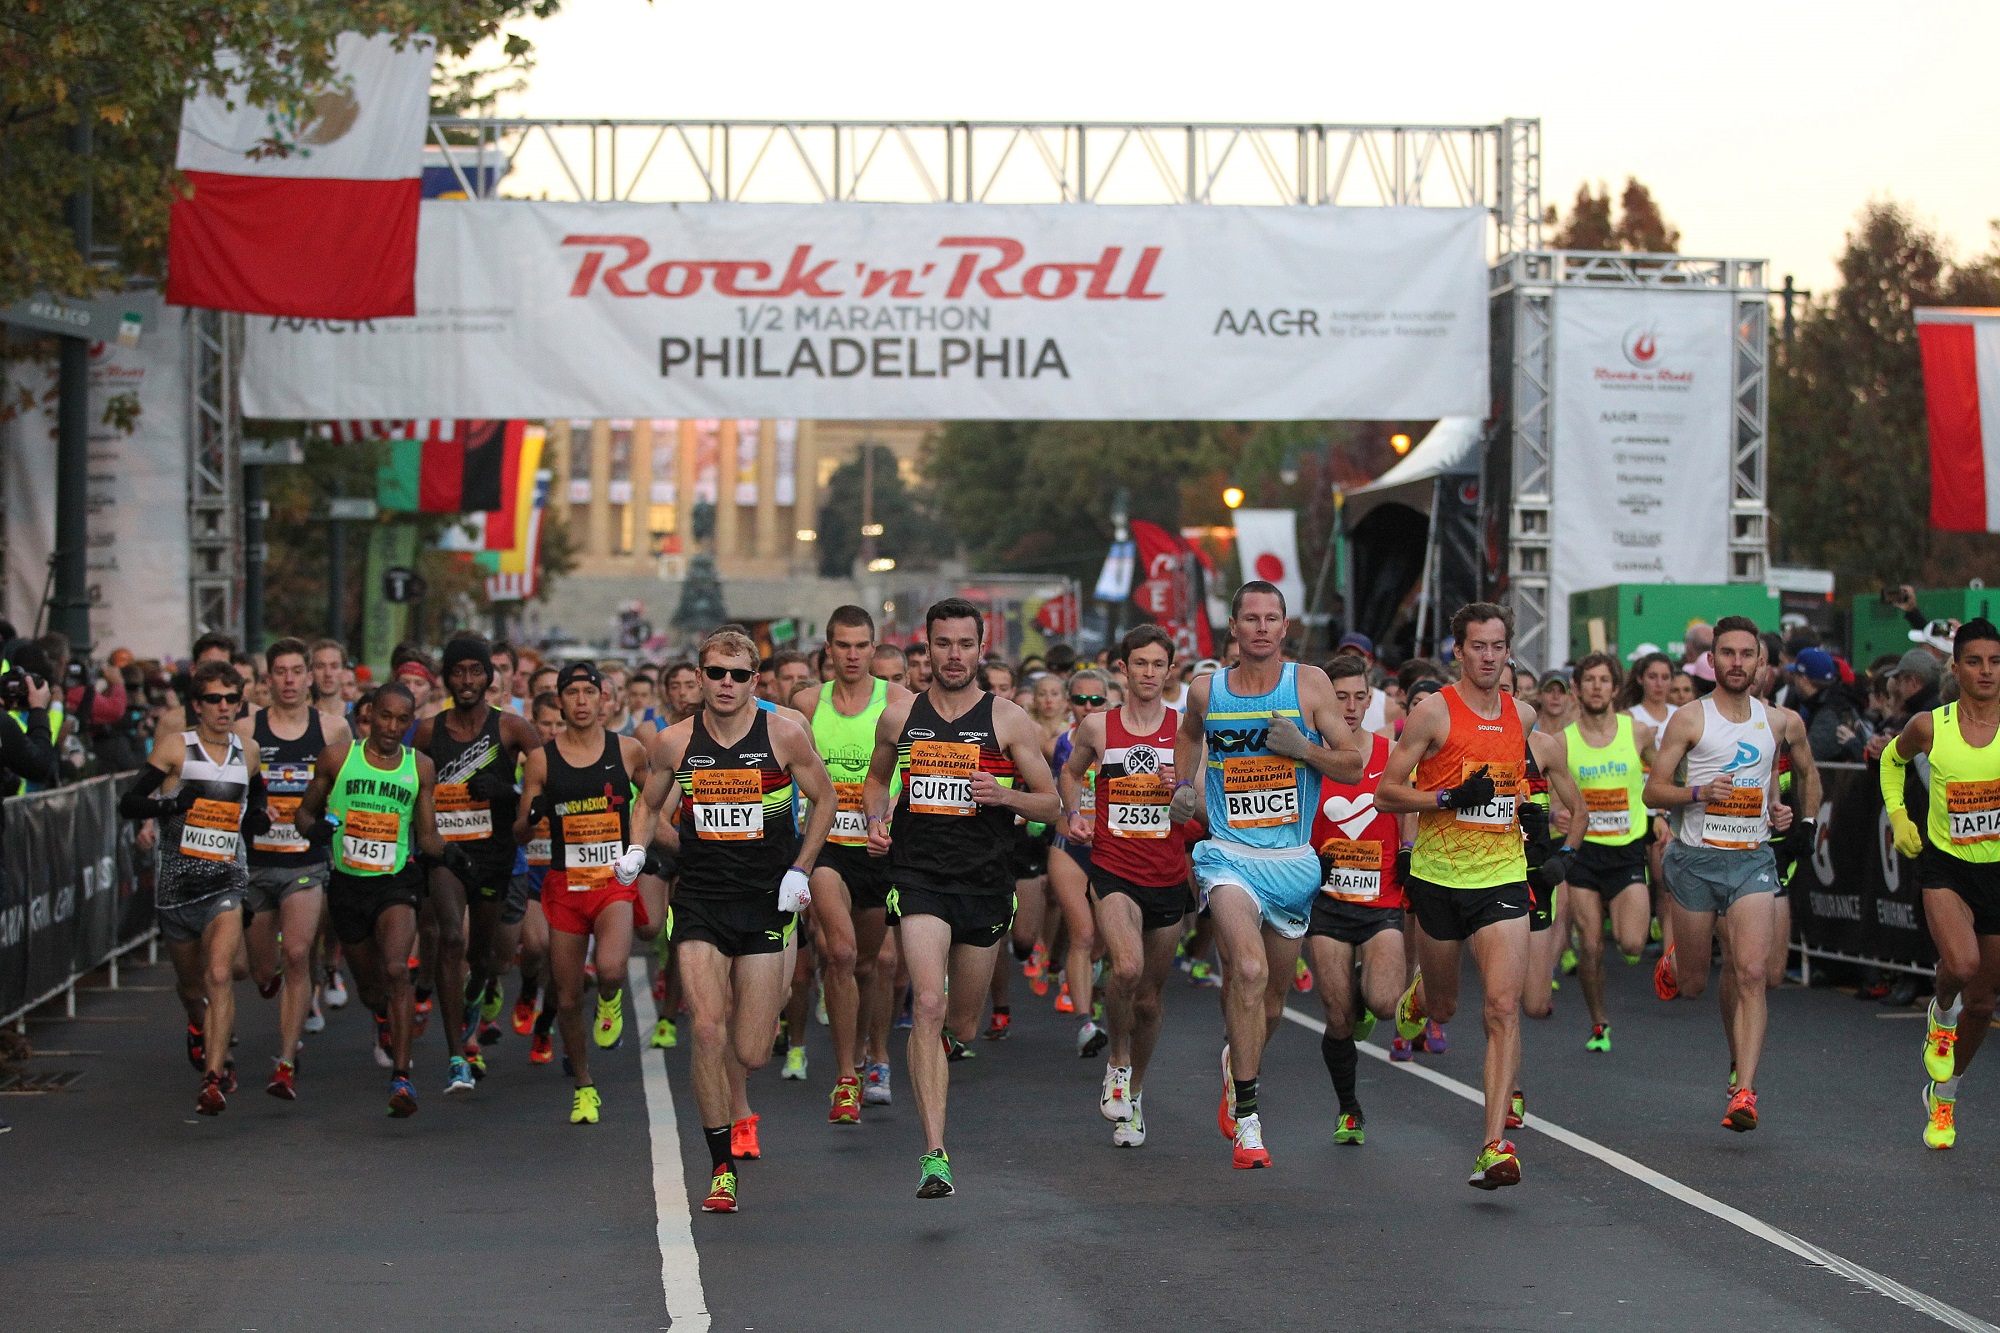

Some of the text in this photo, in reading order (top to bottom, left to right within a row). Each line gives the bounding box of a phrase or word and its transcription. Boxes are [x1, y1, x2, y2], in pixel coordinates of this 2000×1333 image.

[562, 235, 1165, 301] Rock 'n' Roll
[737, 304, 991, 334] 1/2 MARATHON
[1213, 308, 1457, 336] AACR American Association
[1393, 326, 1448, 337] Research
[660, 337, 1070, 378] PHILADELPHIA
[1478, 724, 1503, 733] saucony
[916, 750, 940, 758] Rock
[949, 751, 969, 760] Roll
[911, 759, 976, 769] PHILADELPHIA
[1230, 766, 1254, 774] Rock
[1264, 764, 1285, 772] Roll
[732, 778, 752, 786] Roll
[832, 773, 857, 783] acing
[1226, 771, 1293, 784] PHILADELPHIA
[346, 779, 376, 795] BRYN
[695, 787, 759, 795] PHILADELPHIA
[911, 780, 973, 802] CURTIS
[1111, 789, 1170, 797] PHILADELPHIA
[1228, 792, 1294, 815] BRUCE
[1948, 795, 2000, 804] PHILADELPH
[351, 800, 387, 813] running
[703, 808, 753, 827] RILEY
[1118, 807, 1160, 825] 2536
[1589, 815, 1628, 826] OCHERTY
[1706, 822, 1758, 833] KWIATKOWSKI
[186, 830, 235, 849] WILSON
[267, 829, 301, 840] ONRO
[352, 840, 387, 860] 1451
[579, 845, 616, 864] SHIJE
[1327, 873, 1376, 888] ERAFINI
